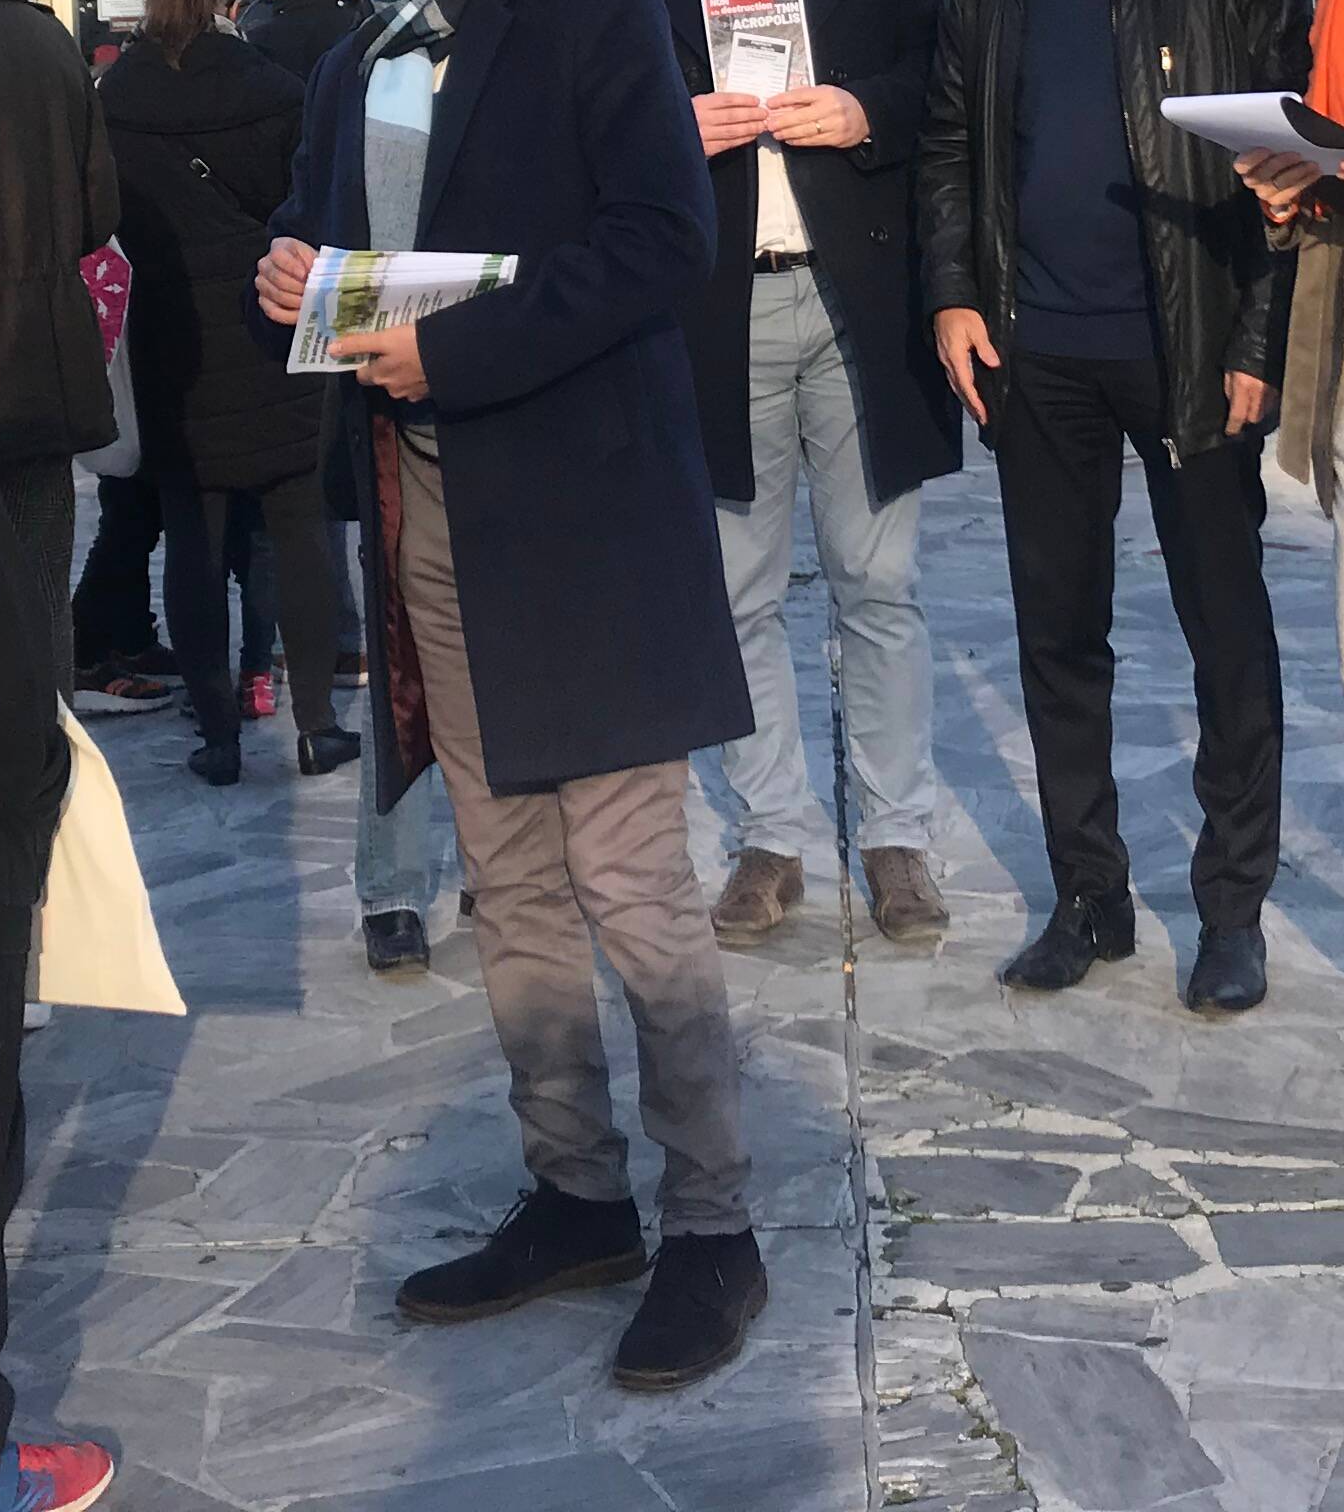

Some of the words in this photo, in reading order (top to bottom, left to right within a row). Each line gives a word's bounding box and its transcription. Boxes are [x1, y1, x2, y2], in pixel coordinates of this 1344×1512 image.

[721, 1, 772, 14] destruction
[774, 2, 800, 14] TNN
[732, 13, 801, 30] ACROPOLIS
